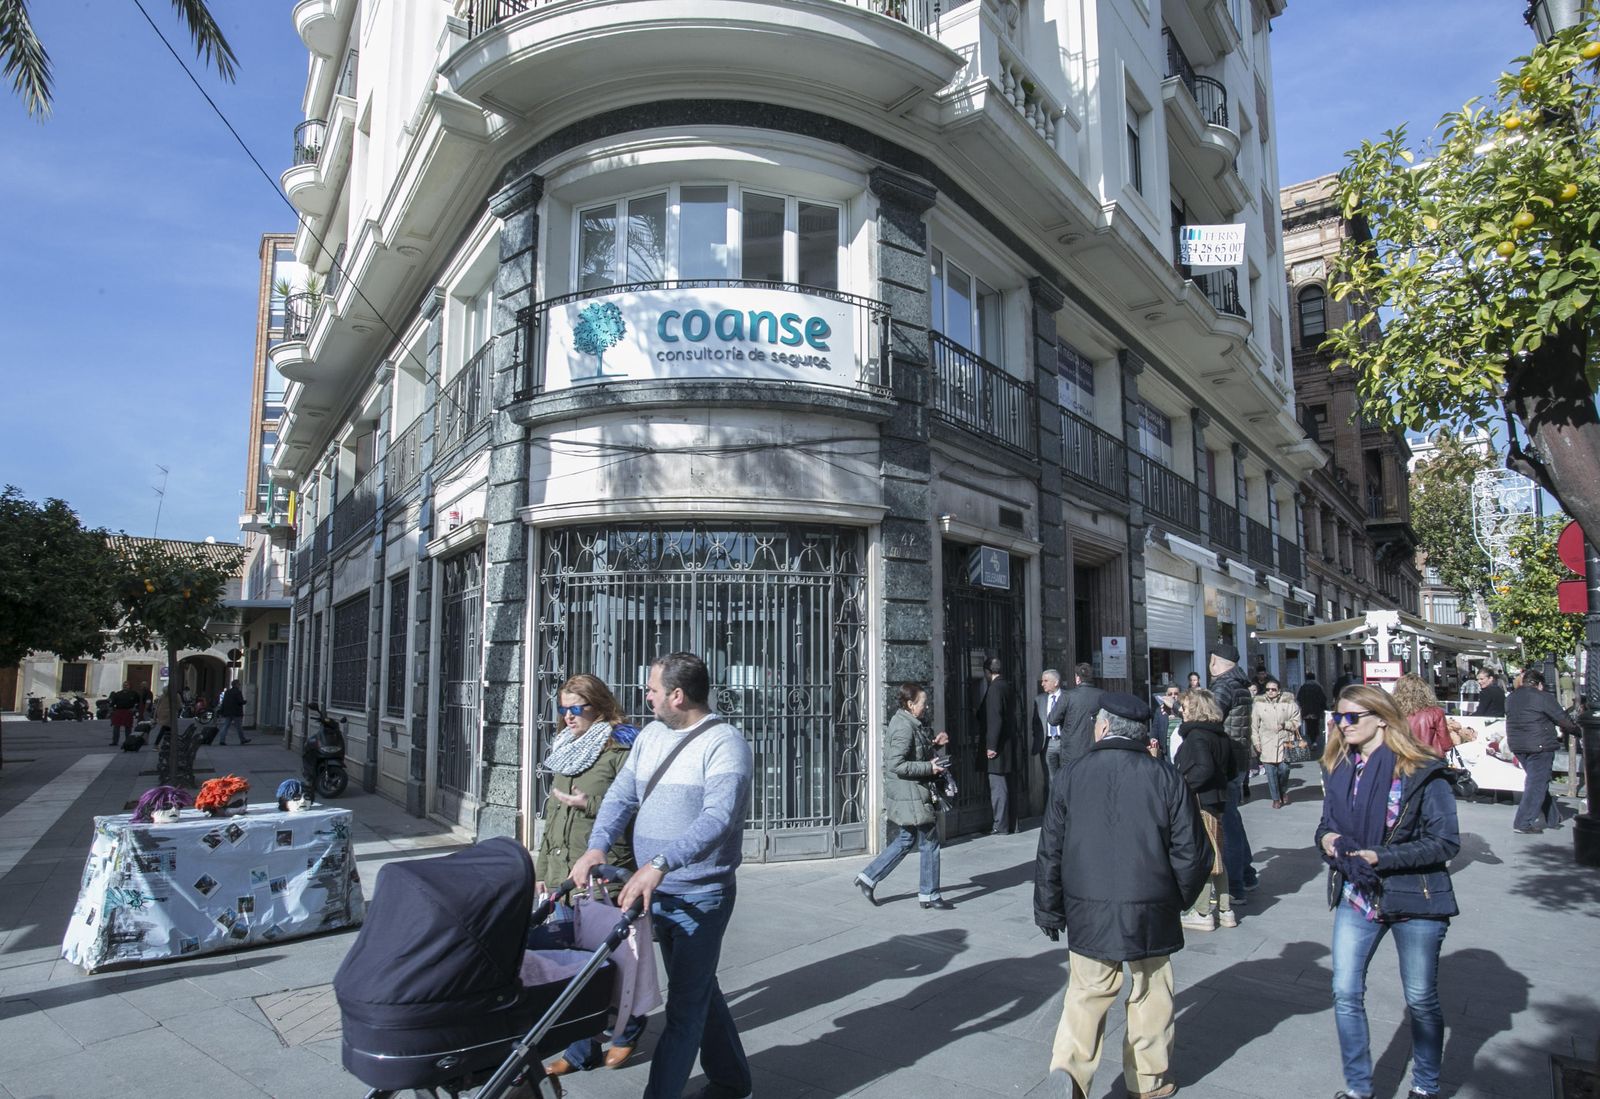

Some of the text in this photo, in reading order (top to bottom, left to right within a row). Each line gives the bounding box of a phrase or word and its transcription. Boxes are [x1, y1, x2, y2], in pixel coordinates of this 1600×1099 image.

[1215, 243, 1226, 253] 65
[1198, 253, 1239, 263] VENDE
[657, 309, 831, 351] coanse
[656, 346, 832, 371] consultoría de seguros
